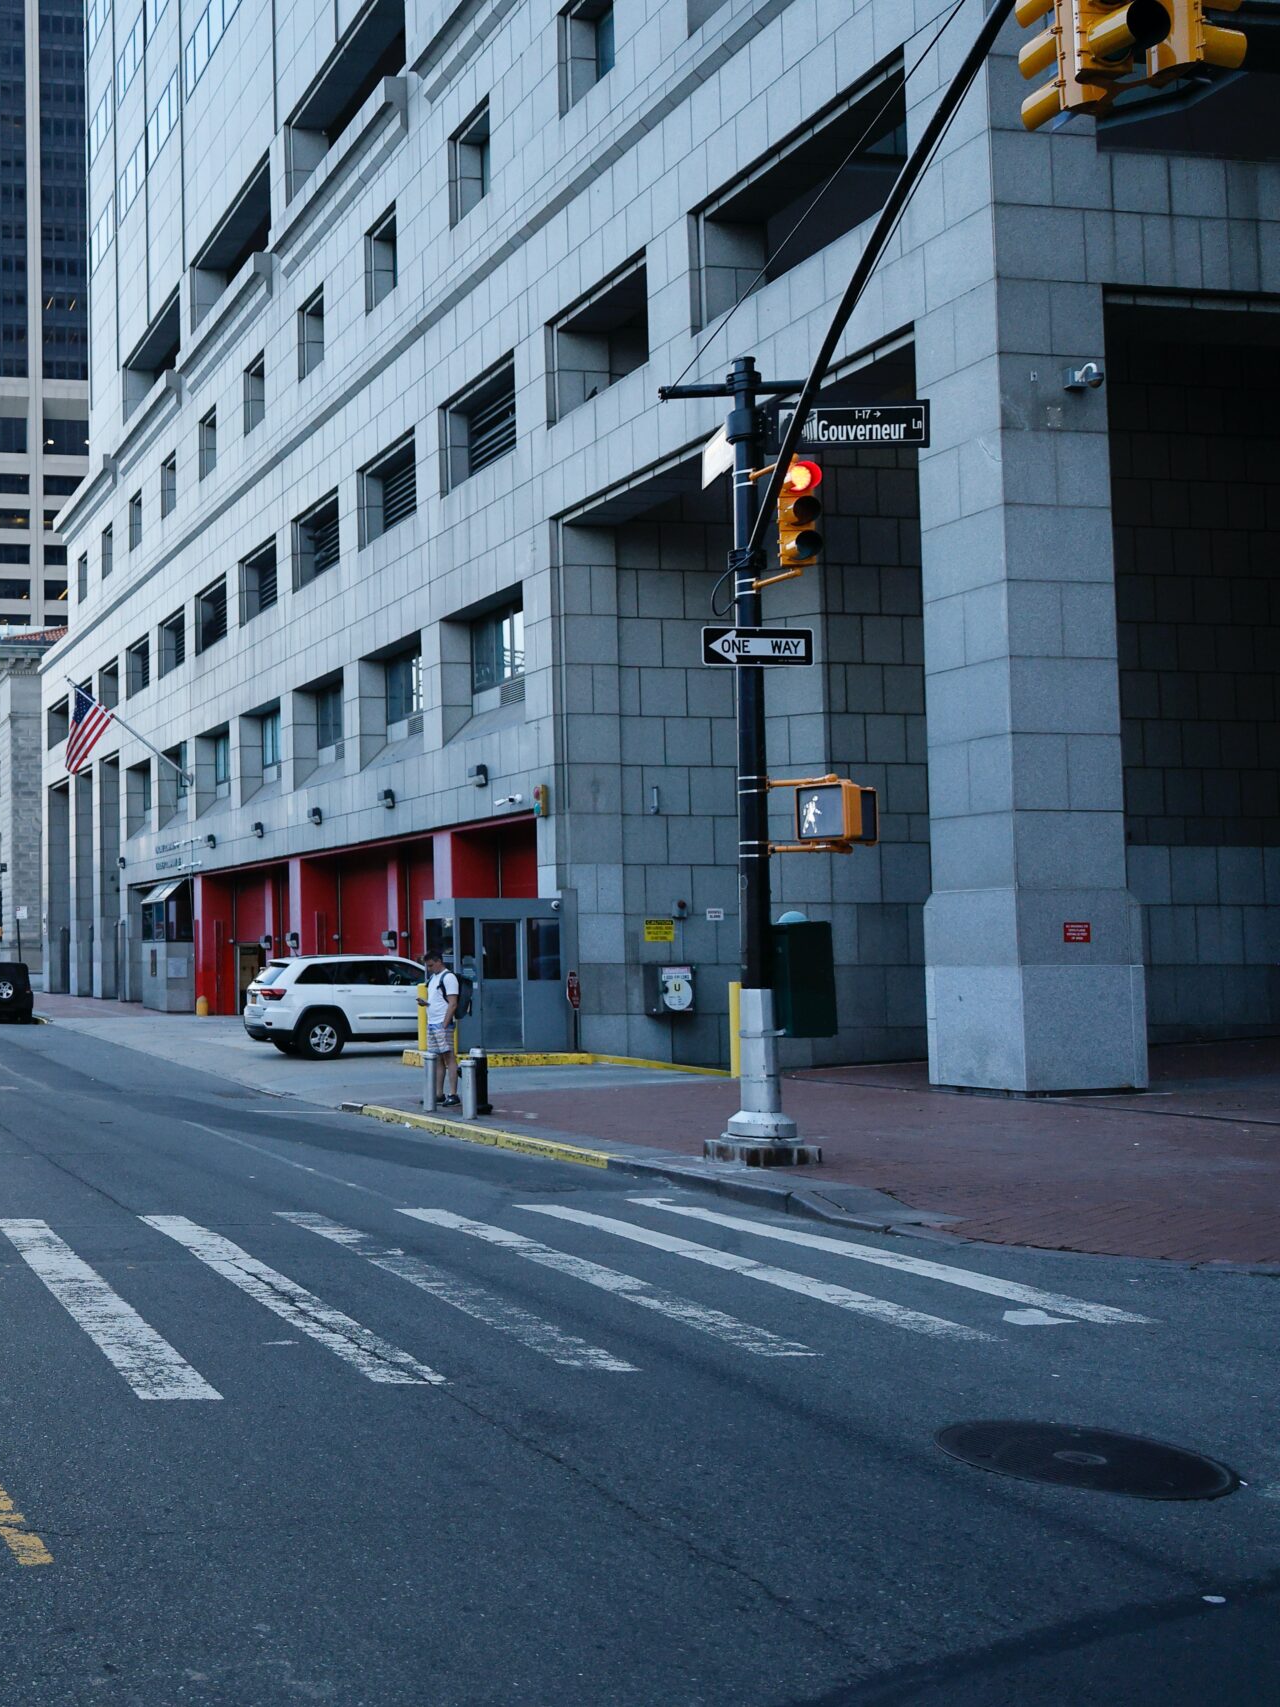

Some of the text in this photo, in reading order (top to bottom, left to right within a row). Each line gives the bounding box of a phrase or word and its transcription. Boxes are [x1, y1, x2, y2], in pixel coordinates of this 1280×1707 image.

[855, 410, 871, 420] 1-17
[818, 418, 922, 441] Gouverneur Ln
[721, 639, 801, 654] ONE WAY
